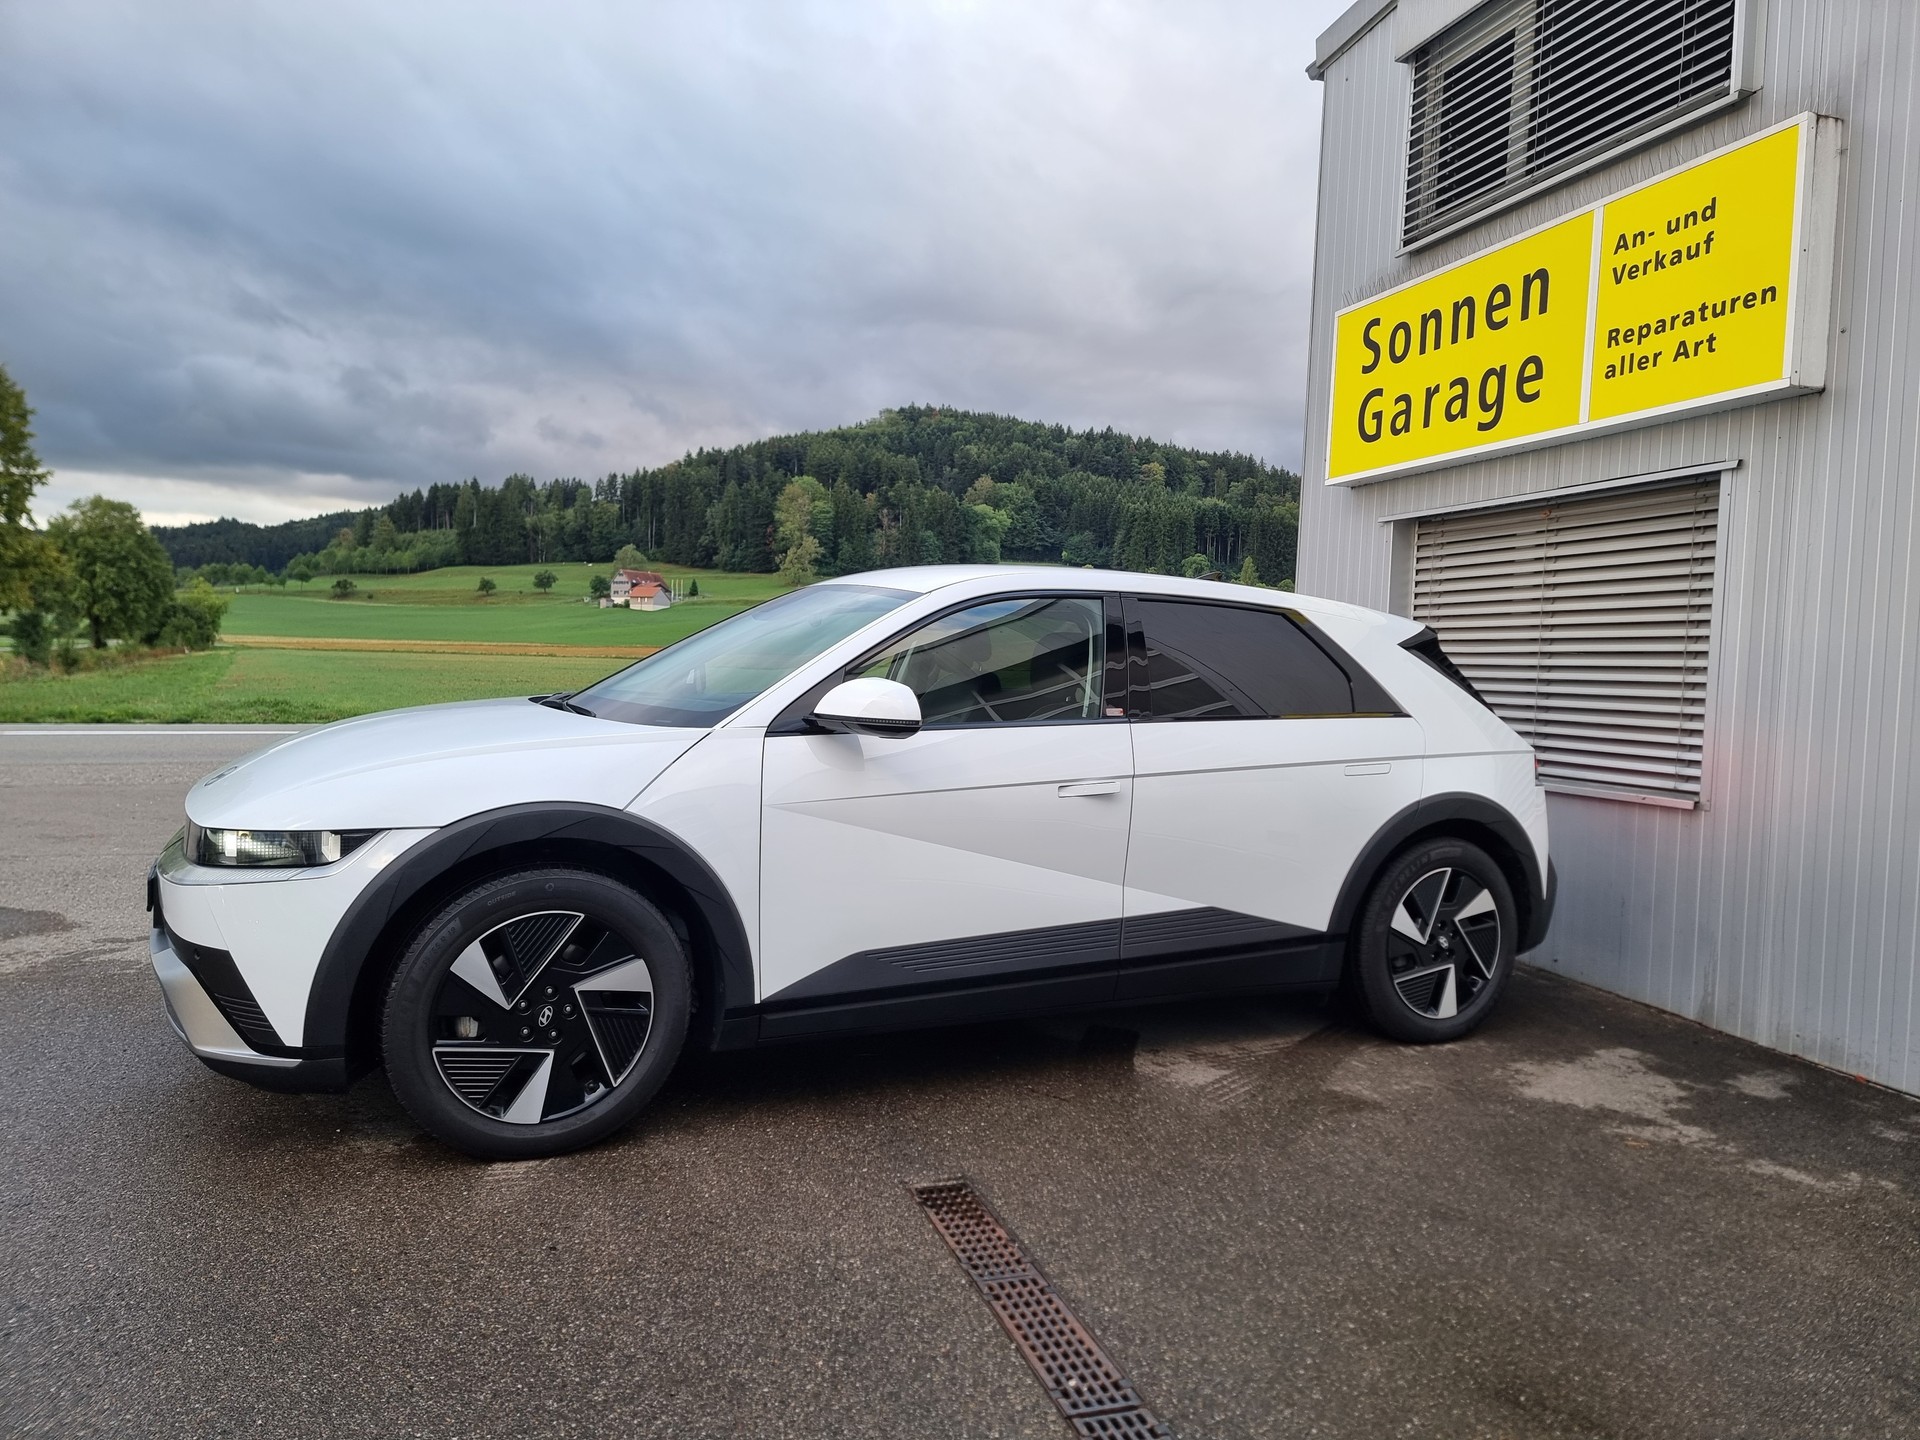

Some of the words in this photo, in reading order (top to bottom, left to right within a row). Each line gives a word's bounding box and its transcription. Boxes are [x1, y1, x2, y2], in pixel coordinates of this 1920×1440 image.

[1613, 230, 1656, 256] An-
[1666, 196, 1717, 235] und
[1612, 230, 1715, 285] Verkauf
[1361, 267, 1550, 374] Sonnen
[1607, 285, 1777, 349] Reparaturen
[1604, 351, 1664, 380] aller
[1672, 332, 1717, 363] Art
[1358, 355, 1544, 443] Garage
[487, 890, 517, 906] OUTSIDE
